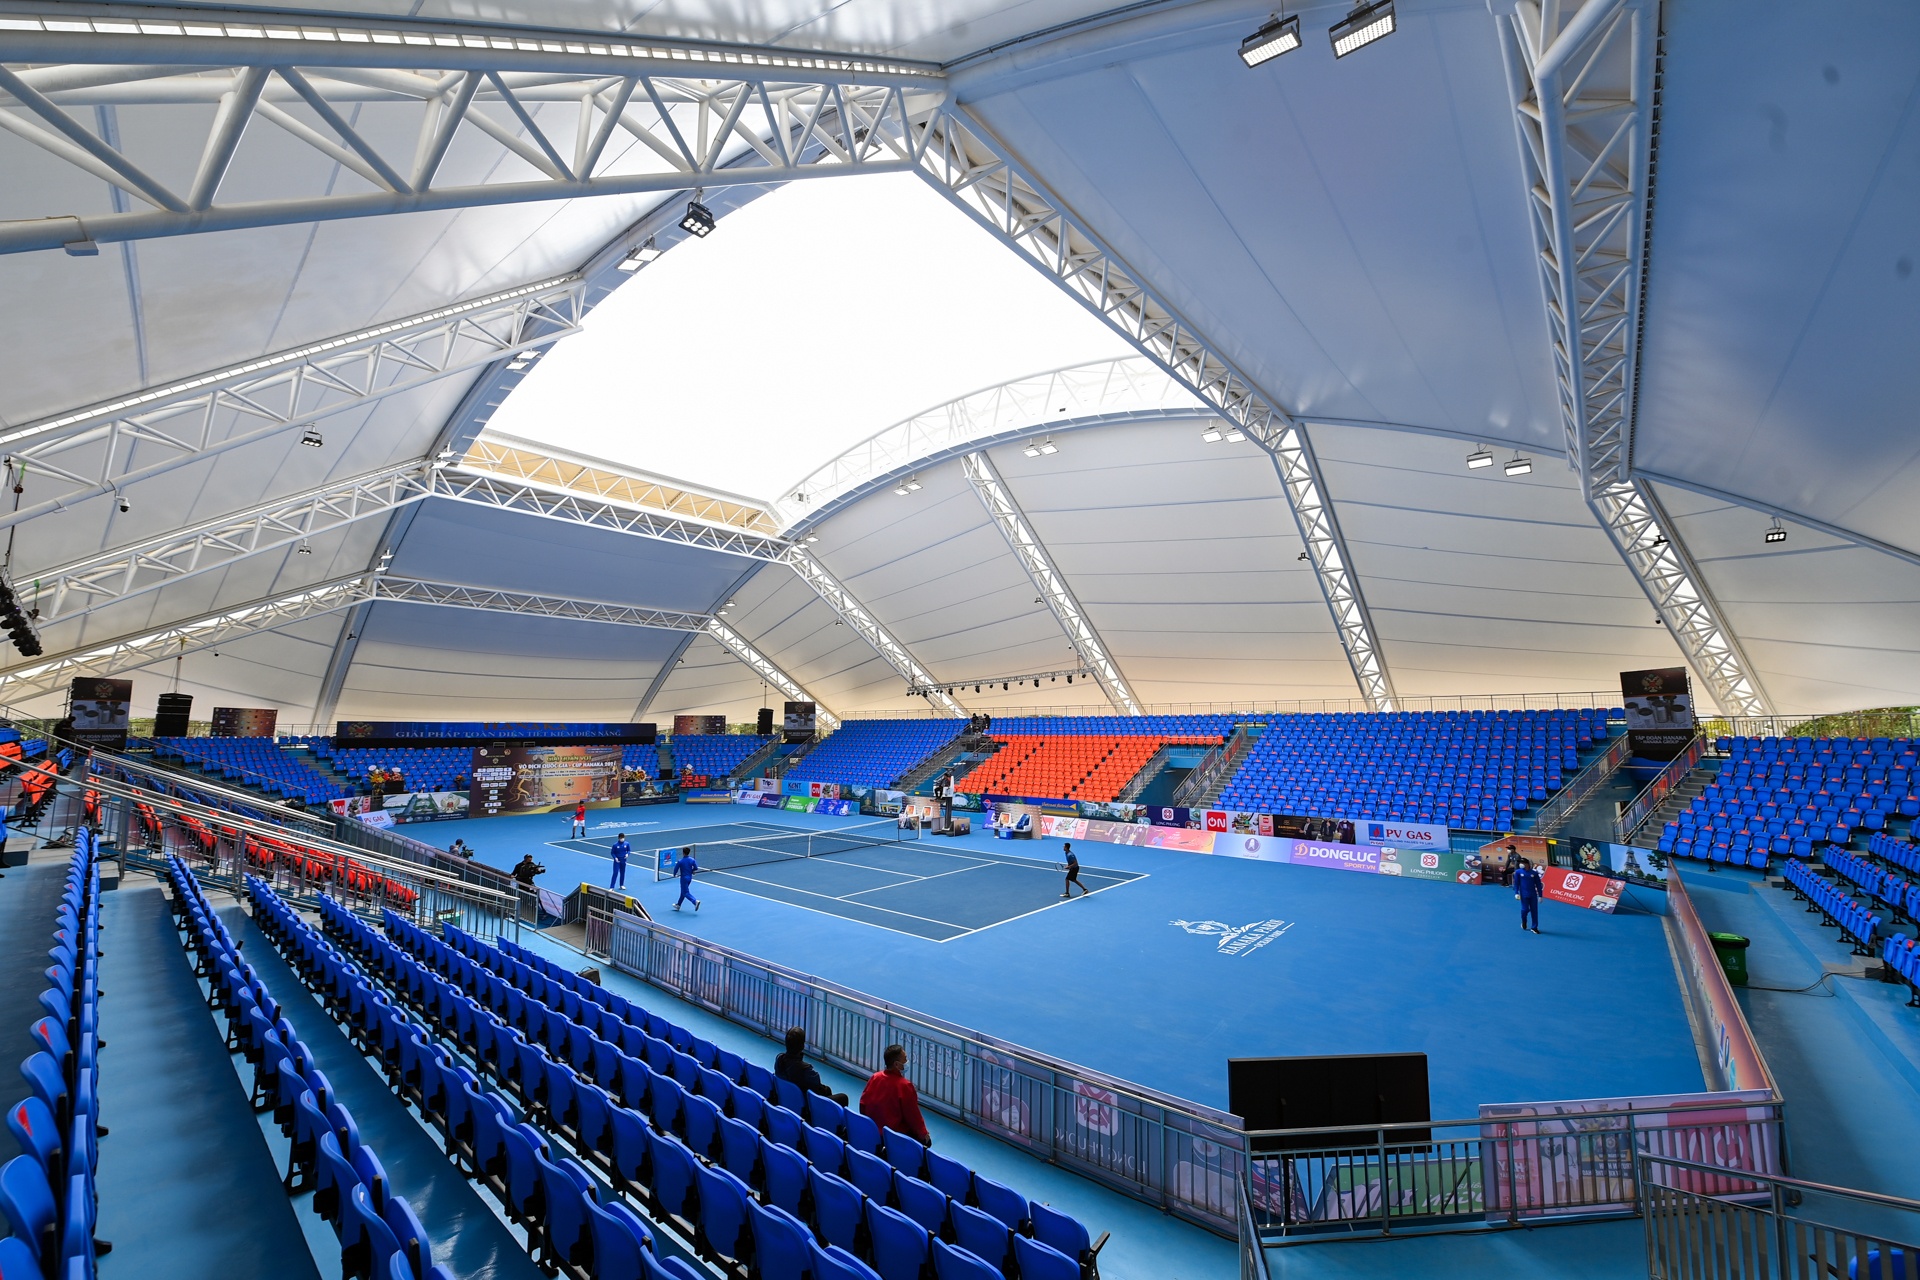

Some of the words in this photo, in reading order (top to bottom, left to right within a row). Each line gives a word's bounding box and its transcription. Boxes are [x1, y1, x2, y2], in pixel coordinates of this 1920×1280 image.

[1207, 817, 1226, 828] ON
[1386, 829, 1402, 838] PV
[1406, 831, 1432, 841] GAS
[1310, 847, 1376, 863] DONGLUC
[1344, 862, 1376, 870] SPORT.VN
[1217, 934, 1264, 955] HANAKA
